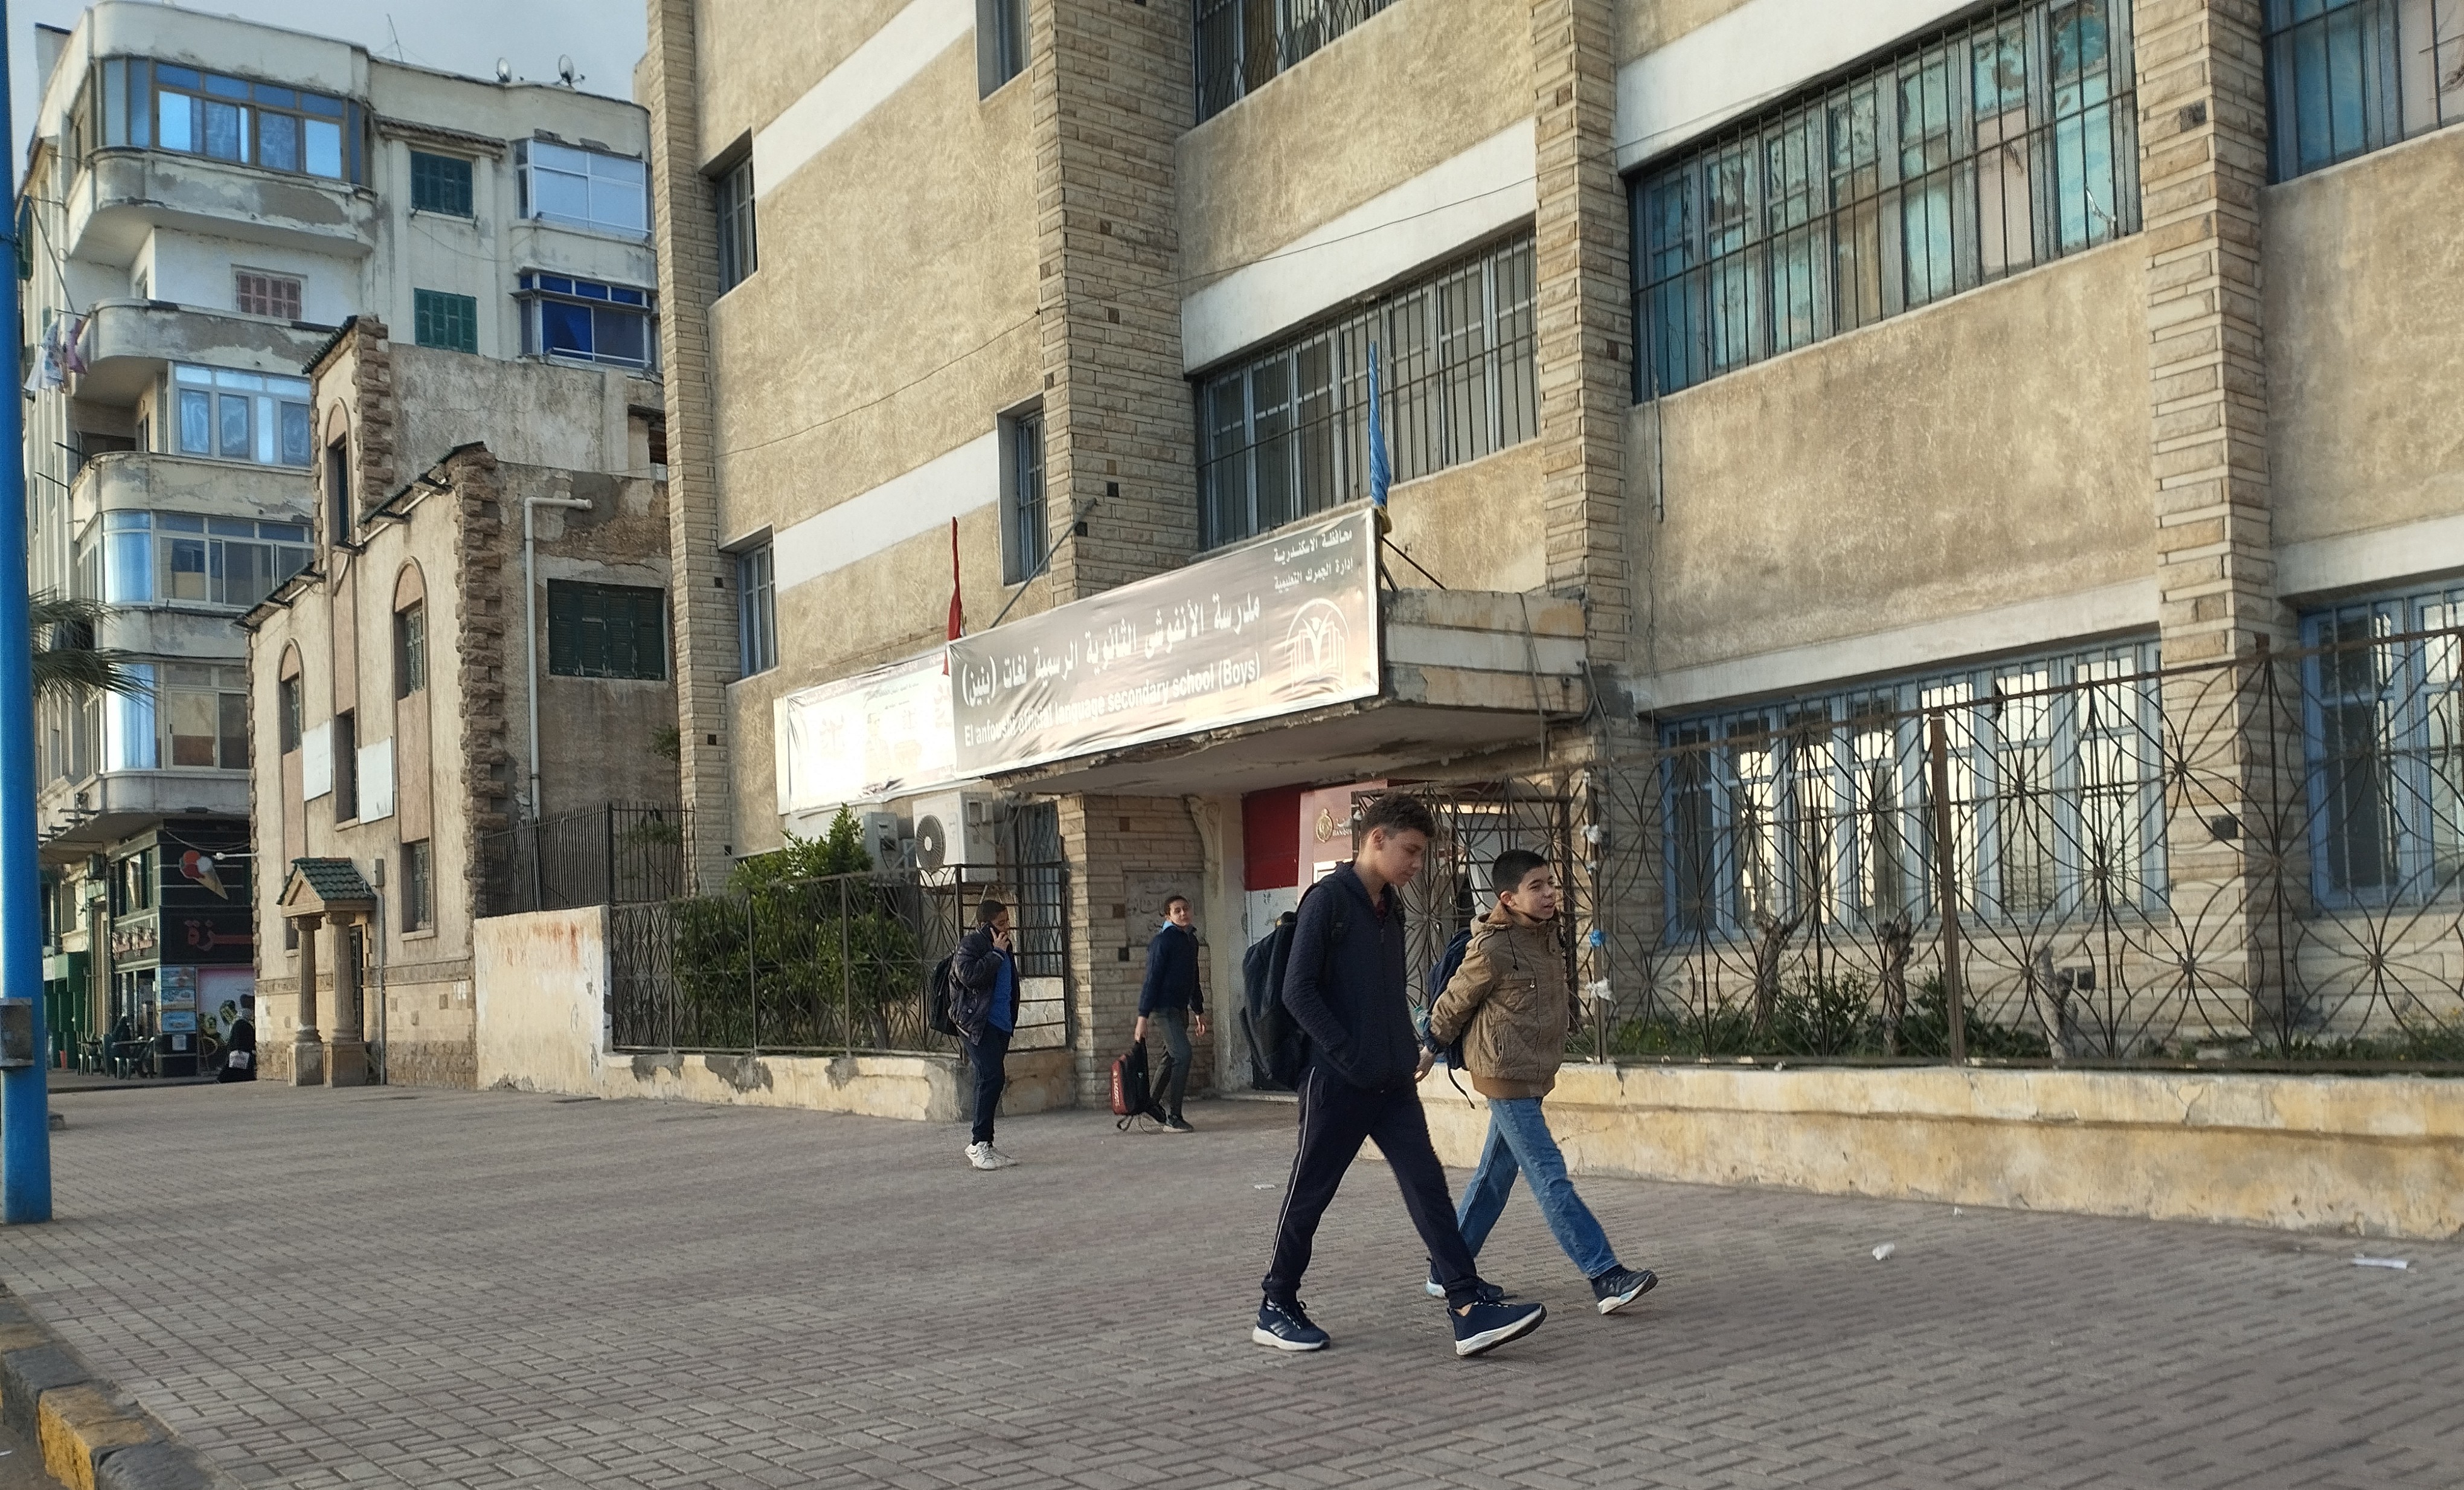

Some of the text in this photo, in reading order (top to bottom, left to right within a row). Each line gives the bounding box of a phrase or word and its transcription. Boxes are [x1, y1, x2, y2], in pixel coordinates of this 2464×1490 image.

[1321, 529, 1352, 548] محافظة
[1274, 571, 1303, 593] التعليمية
[1305, 561, 1331, 583] الجمرك
[1212, 592, 1260, 635] مدرسة
[1033, 639, 1078, 688] الرسمية
[1085, 618, 1137, 675] الثانوية
[962, 656, 996, 707] (بنين)
[1003, 654, 1027, 688] لغات
[964, 724, 974, 747] El
[1054, 695, 1105, 727] language
[1108, 679, 1169, 712] secondary
[1173, 663, 1214, 697] school
[1218, 652, 1260, 692] (Boys)
